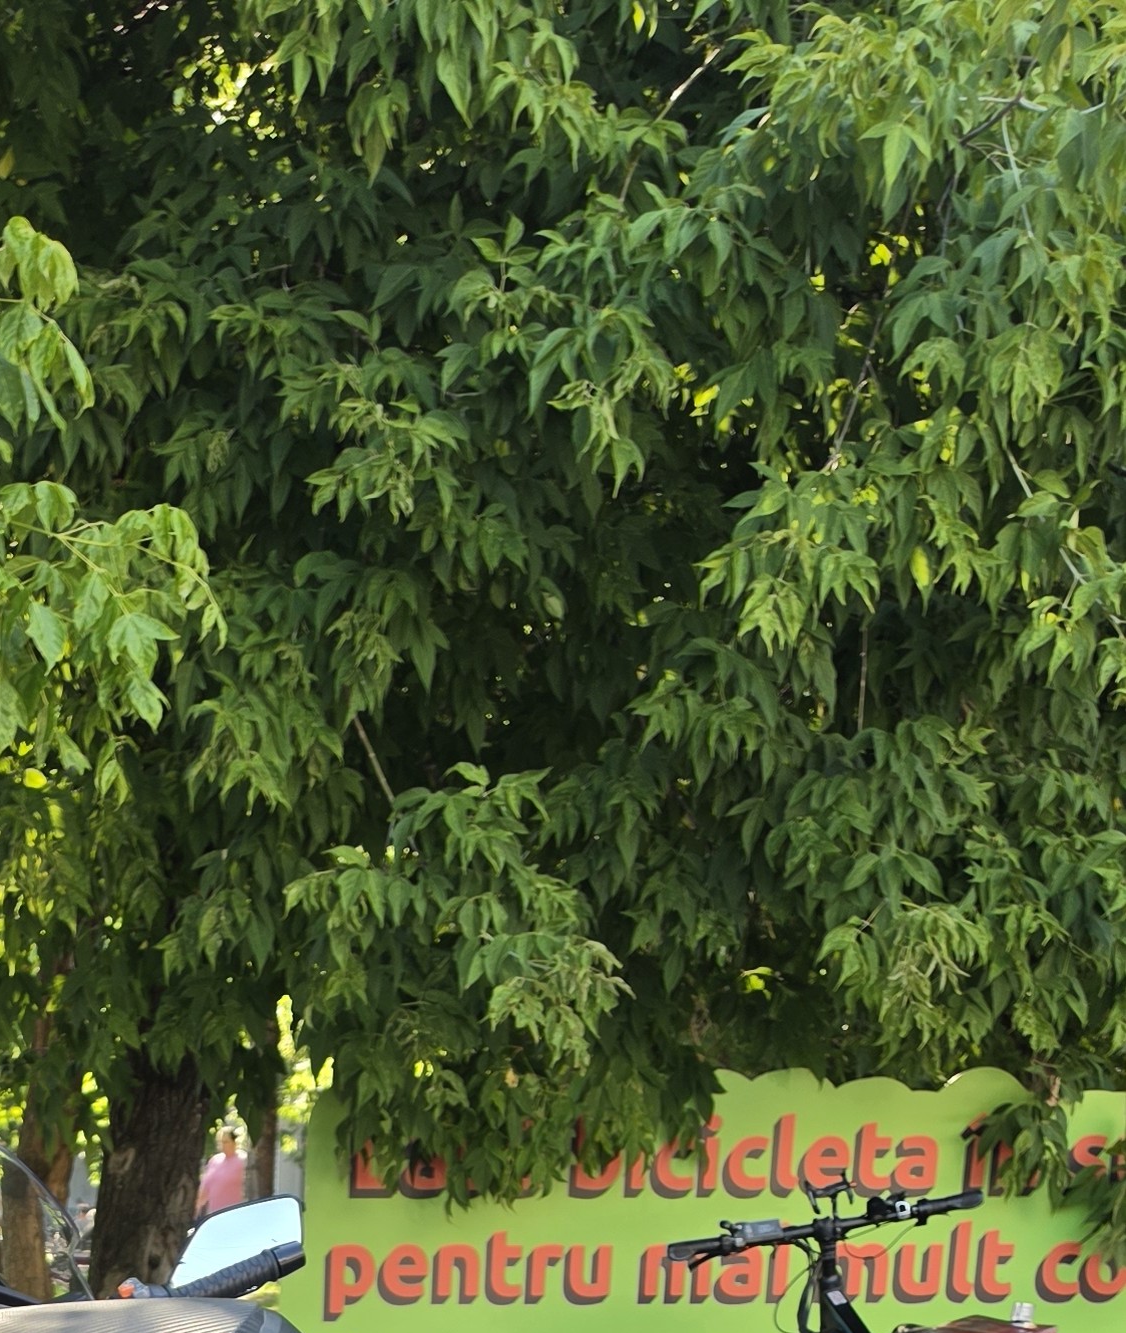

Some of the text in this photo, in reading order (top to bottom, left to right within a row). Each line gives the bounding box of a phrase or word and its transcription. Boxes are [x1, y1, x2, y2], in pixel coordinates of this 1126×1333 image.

[323, 1231, 614, 1321] pentru
[638, 1221, 791, 1304] mai
[831, 1220, 1014, 1304] mult
